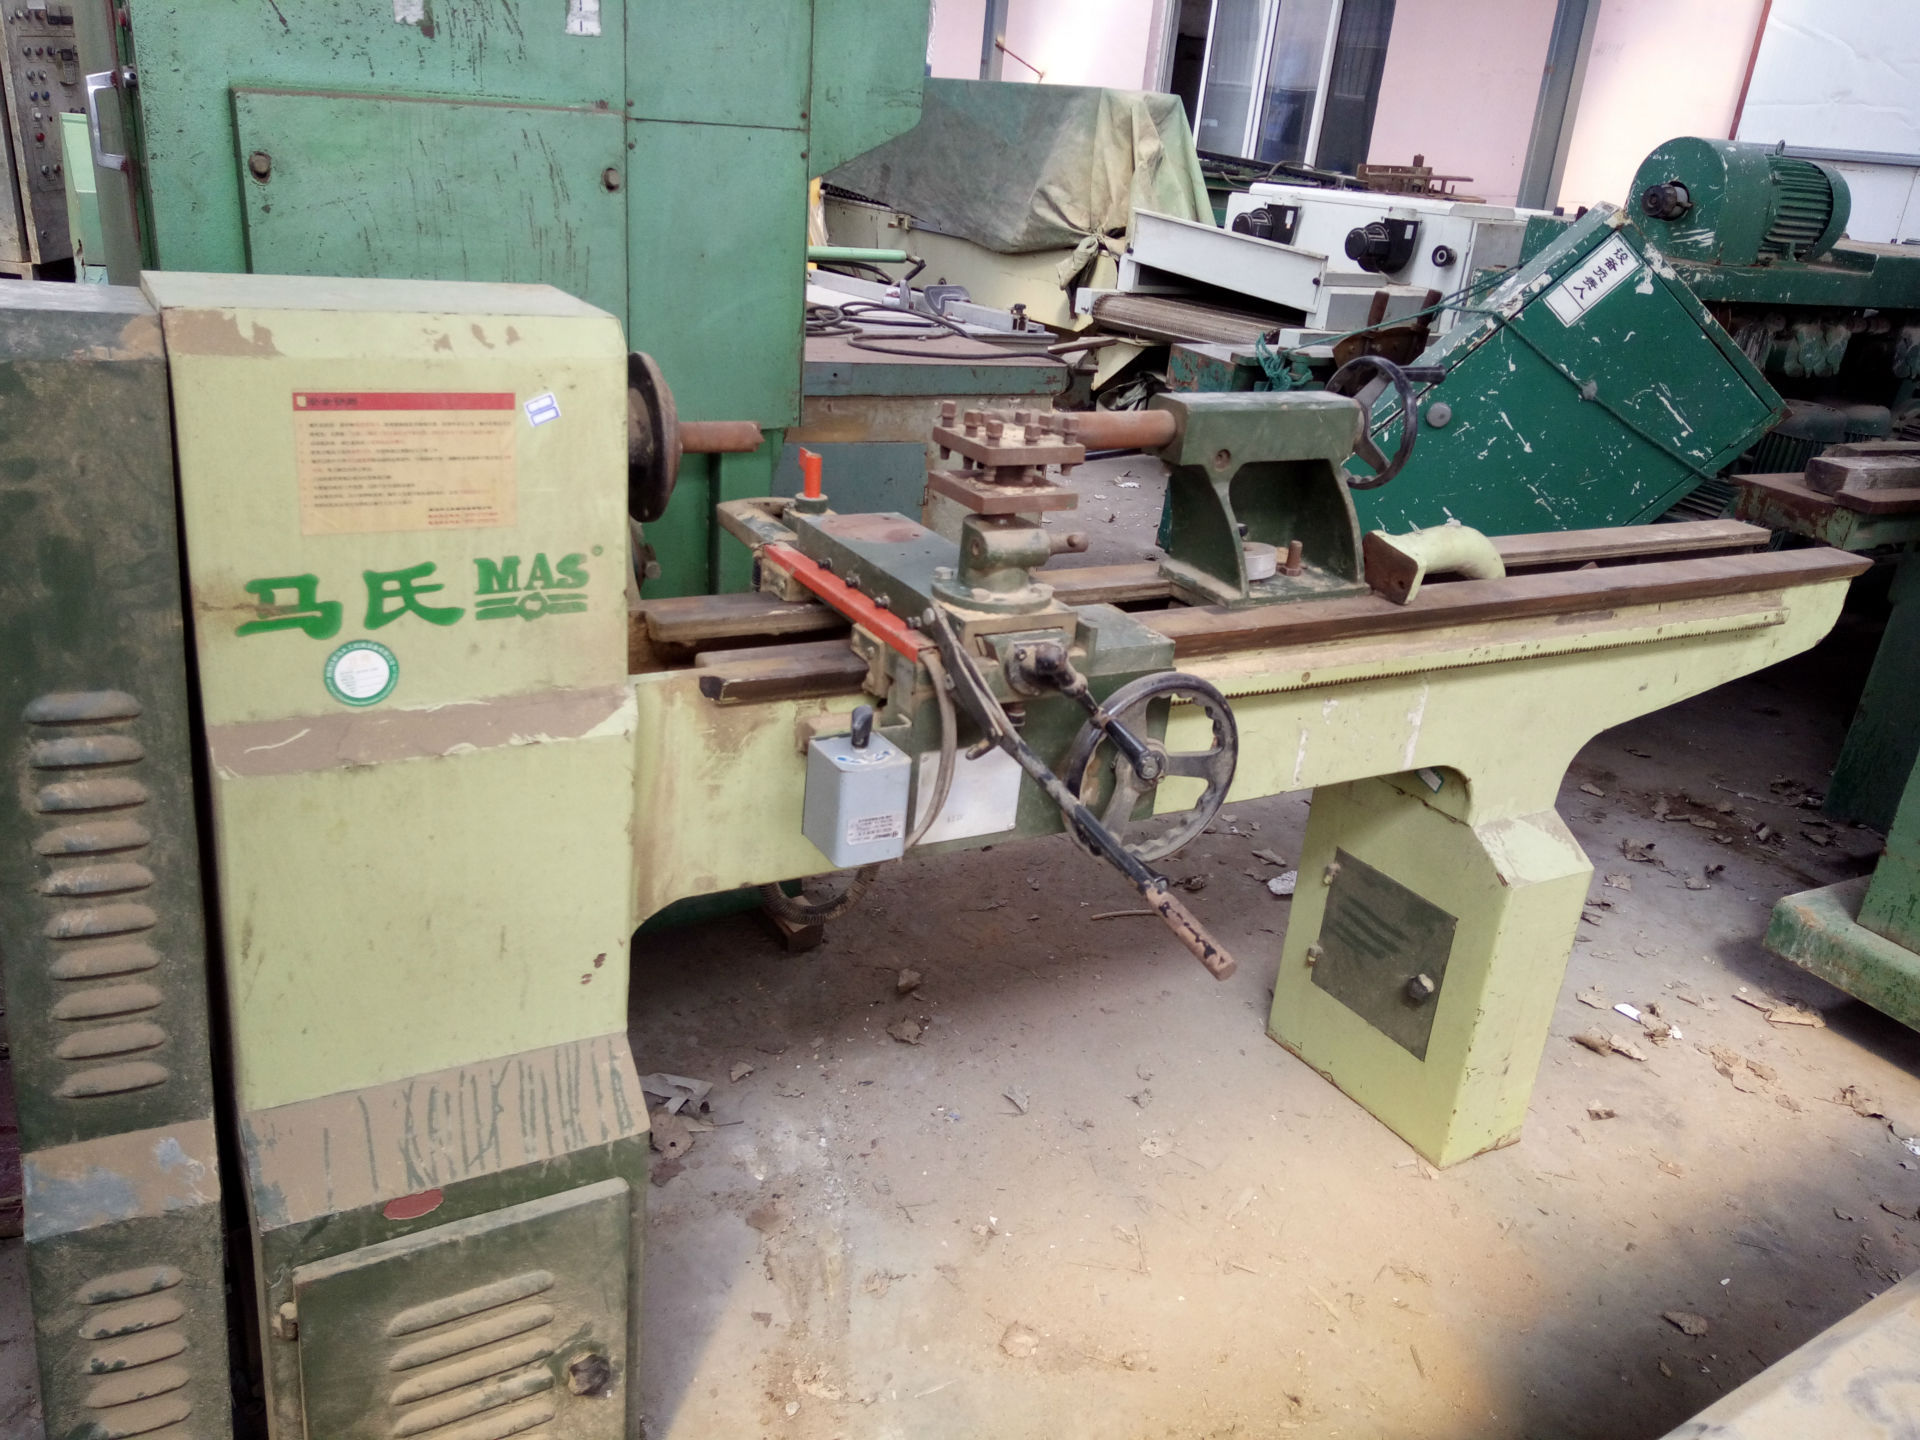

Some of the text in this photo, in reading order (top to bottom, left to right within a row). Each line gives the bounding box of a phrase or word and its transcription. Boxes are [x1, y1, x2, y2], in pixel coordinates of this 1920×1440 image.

[1573, 248, 1629, 300] 设备负责人
[473, 553, 590, 595] MAS
[235, 561, 466, 640] 马氏
